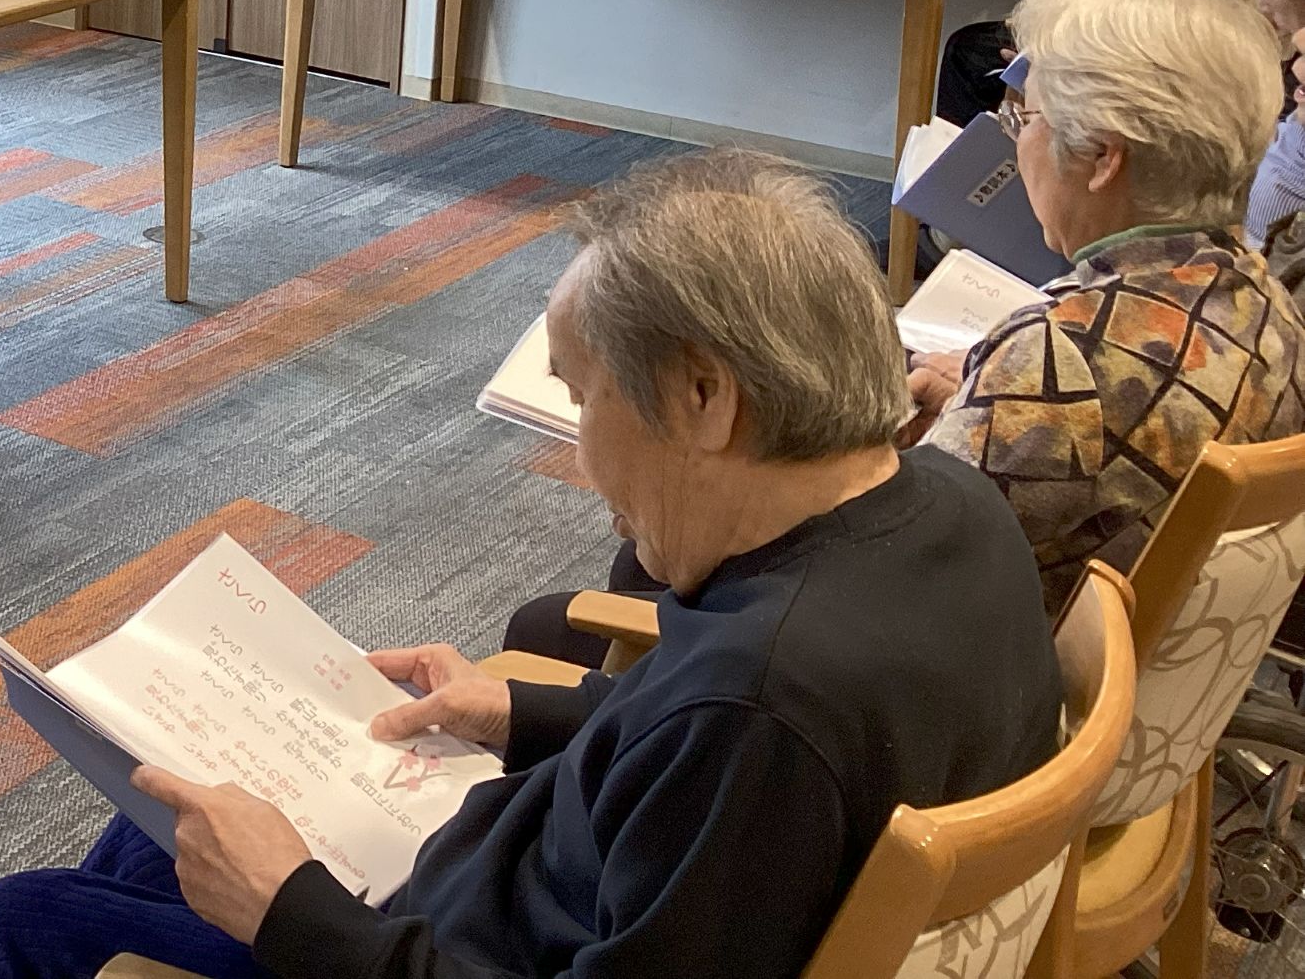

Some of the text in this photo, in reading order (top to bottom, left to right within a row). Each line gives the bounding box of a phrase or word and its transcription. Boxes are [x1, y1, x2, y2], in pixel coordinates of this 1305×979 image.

[962, 273, 1000, 299] さくら
[218, 568, 266, 614] さくら
[153, 669, 185, 697] さくら
[203, 644, 266, 702] 見わたす限り
[210, 625, 242, 655] さくら
[251, 662, 283, 693] さくら
[289, 698, 349, 750] 野山も里も
[201, 671, 234, 699] さくら
[242, 706, 275, 735] さくら
